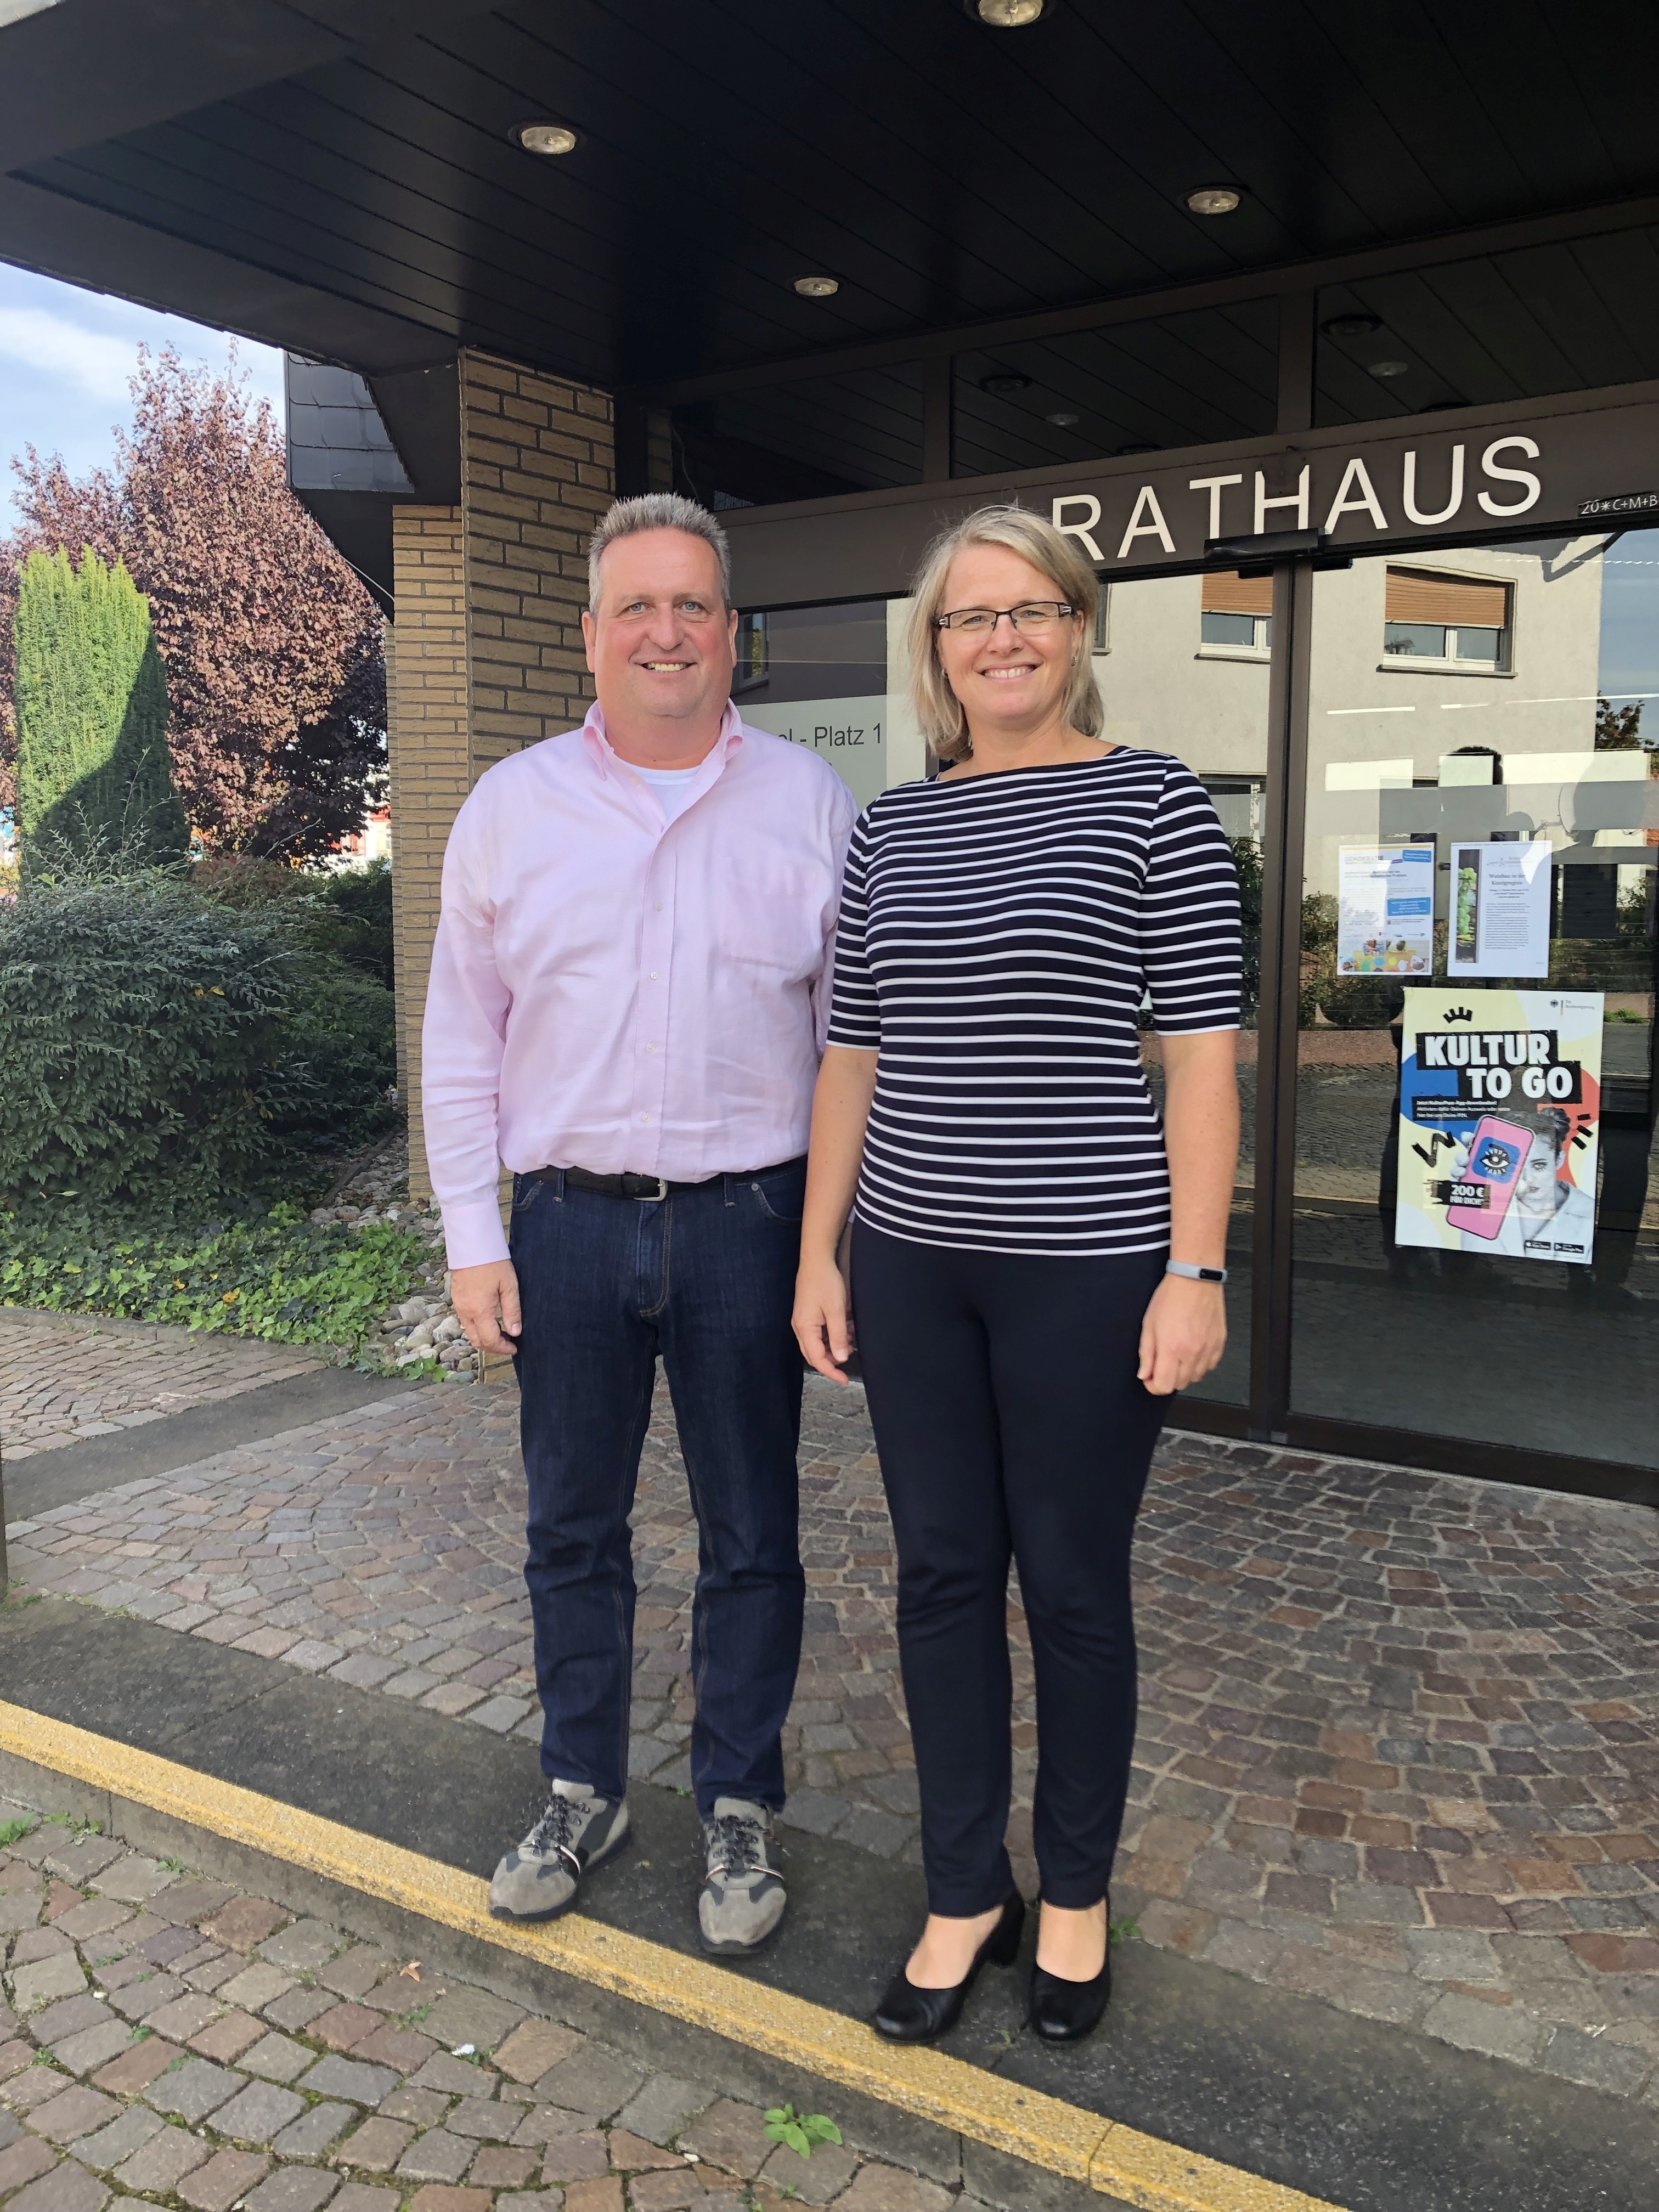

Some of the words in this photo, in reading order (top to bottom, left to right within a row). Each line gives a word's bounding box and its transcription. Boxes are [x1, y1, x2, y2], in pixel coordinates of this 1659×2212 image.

[1052, 436, 1542, 561] RATHAUS
[815, 725, 865, 747] Platz
[873, 723, 881, 744] 1
[1425, 1033, 1551, 1066] KULTUR
[1466, 1067, 1512, 1099] TO
[1521, 1066, 1573, 1099] GO
[1451, 1184, 1475, 1197] 200
[1476, 1187, 1485, 1198] €
